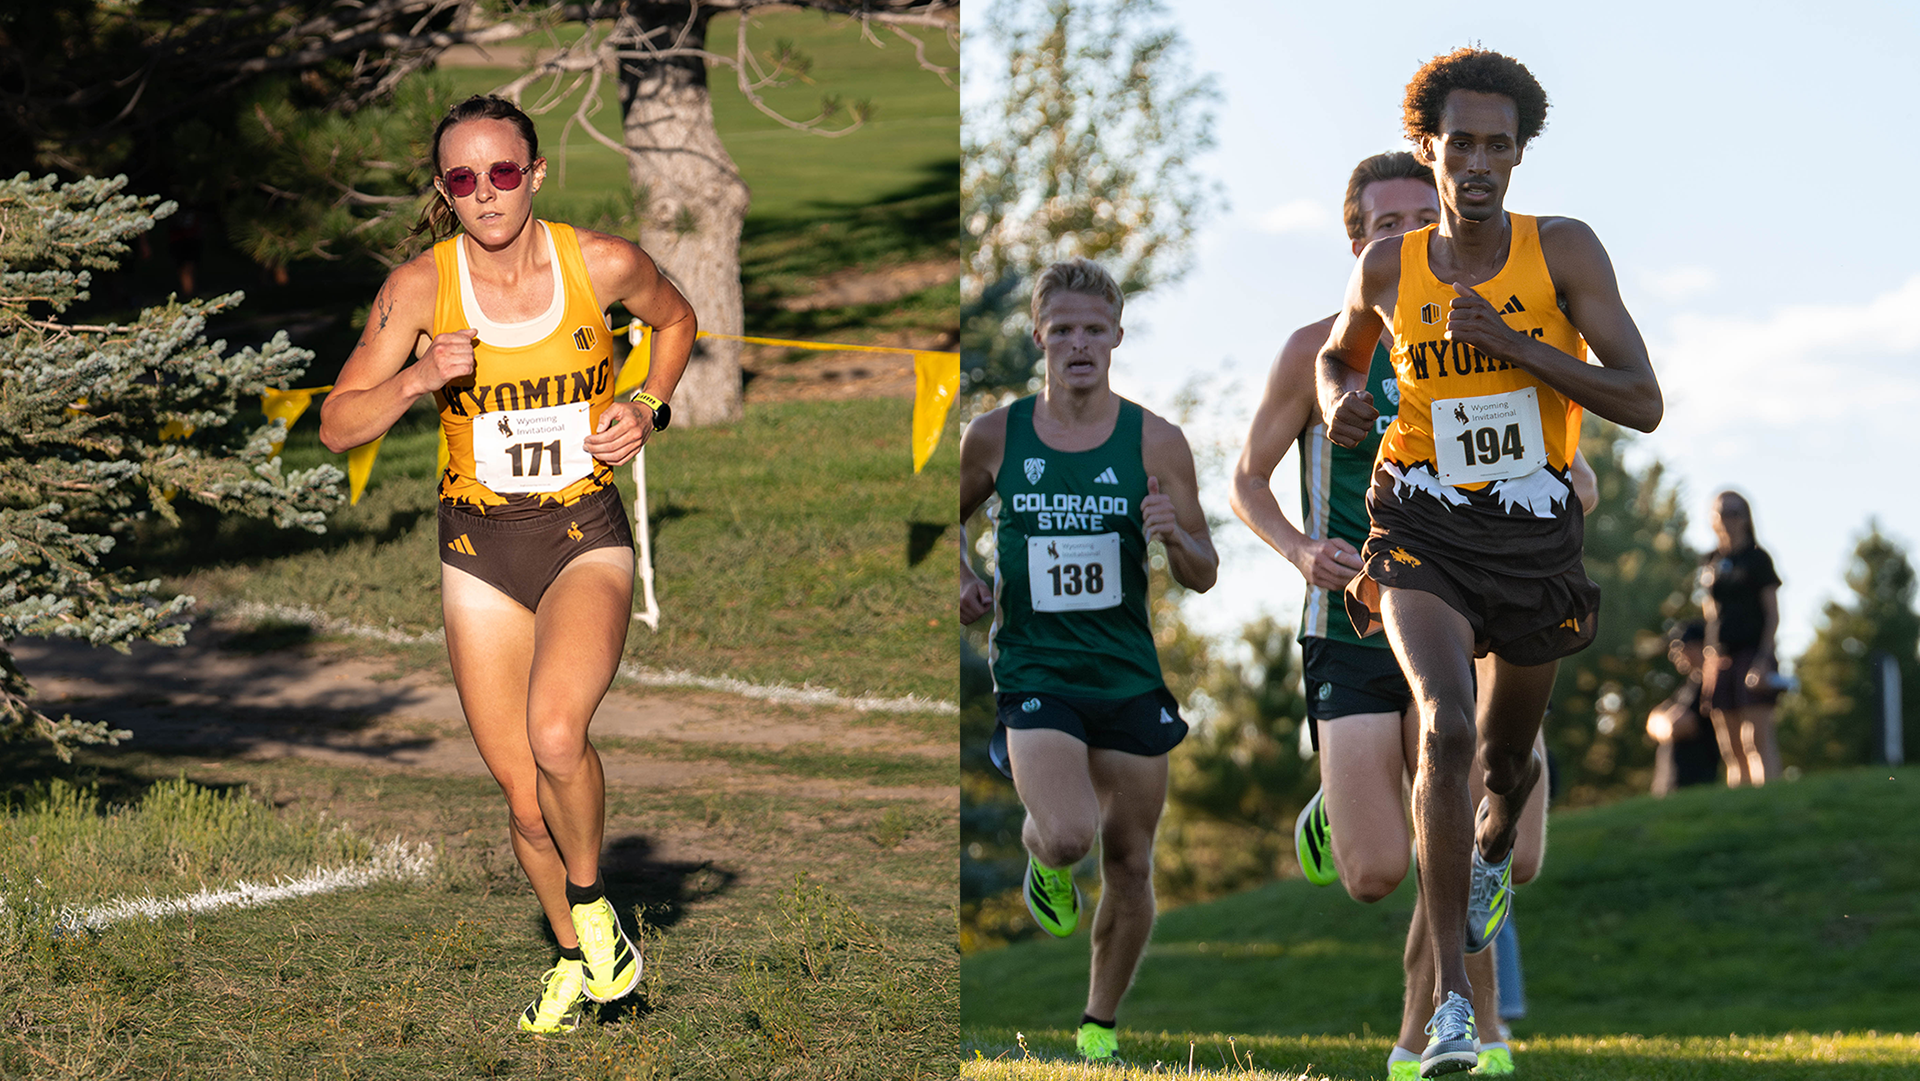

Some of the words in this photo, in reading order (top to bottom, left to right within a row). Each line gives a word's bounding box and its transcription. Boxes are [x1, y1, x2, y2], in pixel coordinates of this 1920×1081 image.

[1408, 327, 1544, 380] WYOM
[1471, 402, 1509, 413] Wyoming
[1472, 409, 1517, 421] Invitational
[516, 415, 557, 426] Wyoming
[517, 424, 565, 435] Invitational
[1456, 422, 1525, 467] 194
[505, 439, 562, 477] 171
[1013, 493, 1128, 515] COLORADO
[1038, 512, 1104, 531] STATE
[1047, 562, 1104, 596] 138
